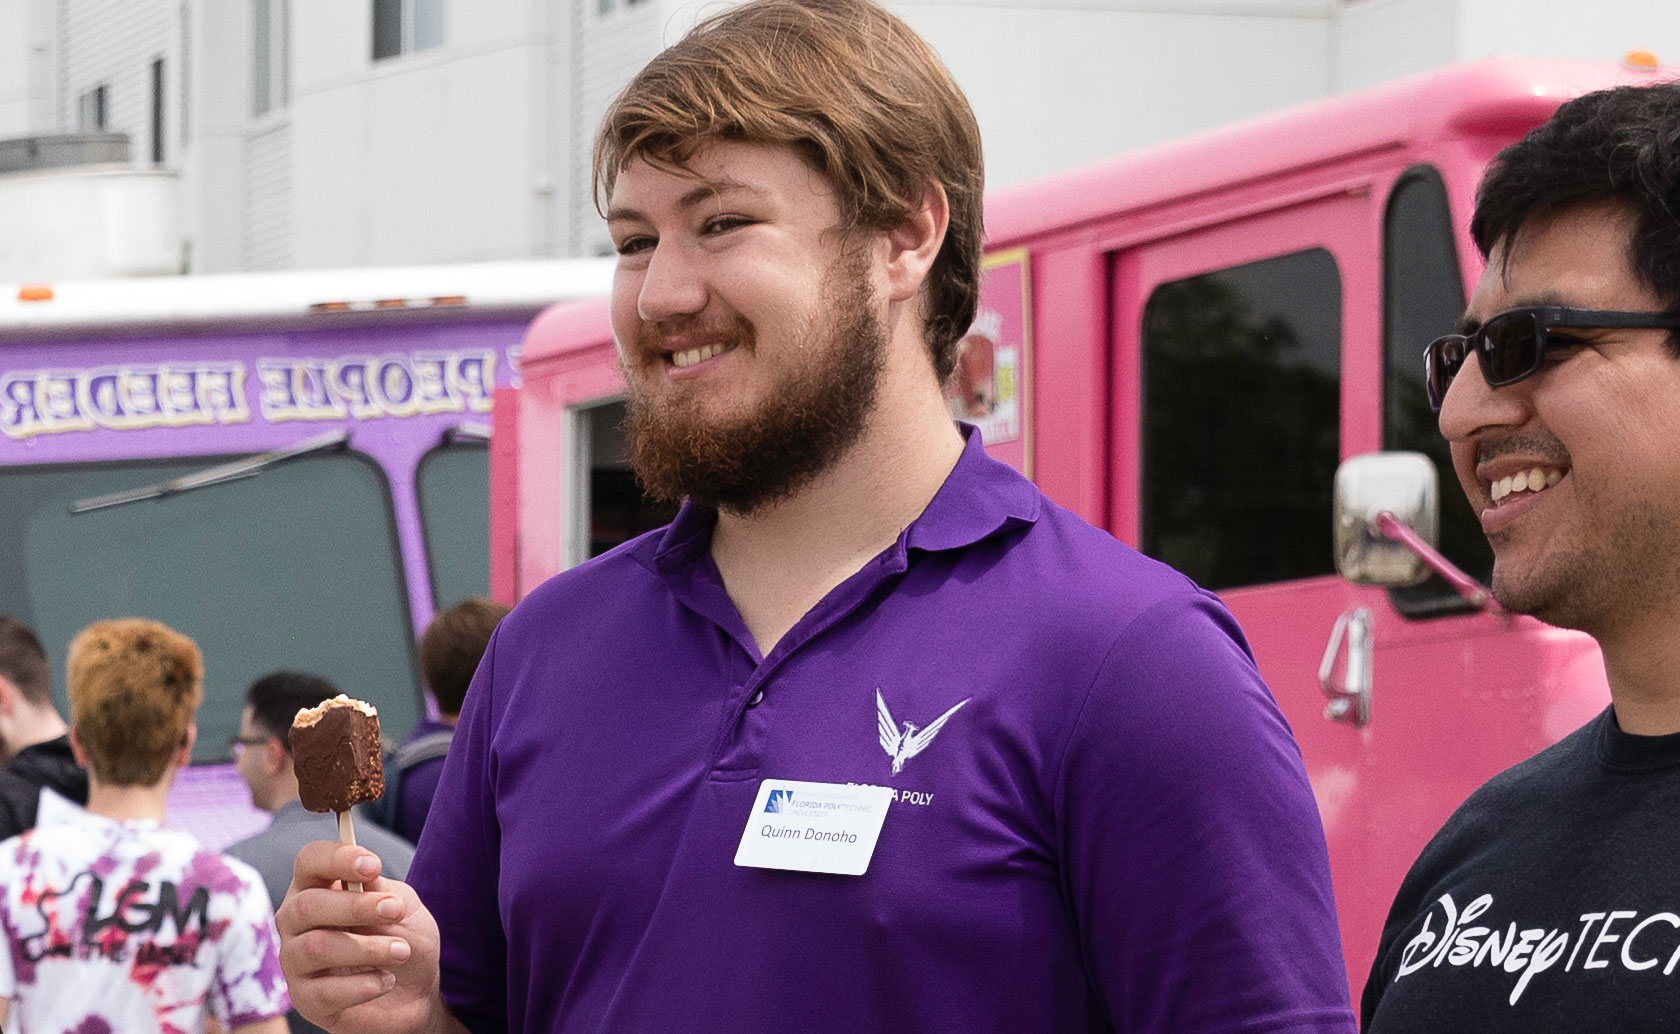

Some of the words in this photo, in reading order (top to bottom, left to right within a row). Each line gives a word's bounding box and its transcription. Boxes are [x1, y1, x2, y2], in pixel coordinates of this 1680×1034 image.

[901, 790, 935, 806] POLY
[760, 824, 801, 840] Quinn
[804, 827, 858, 844] Donoho
[82, 875, 211, 941] LGM
